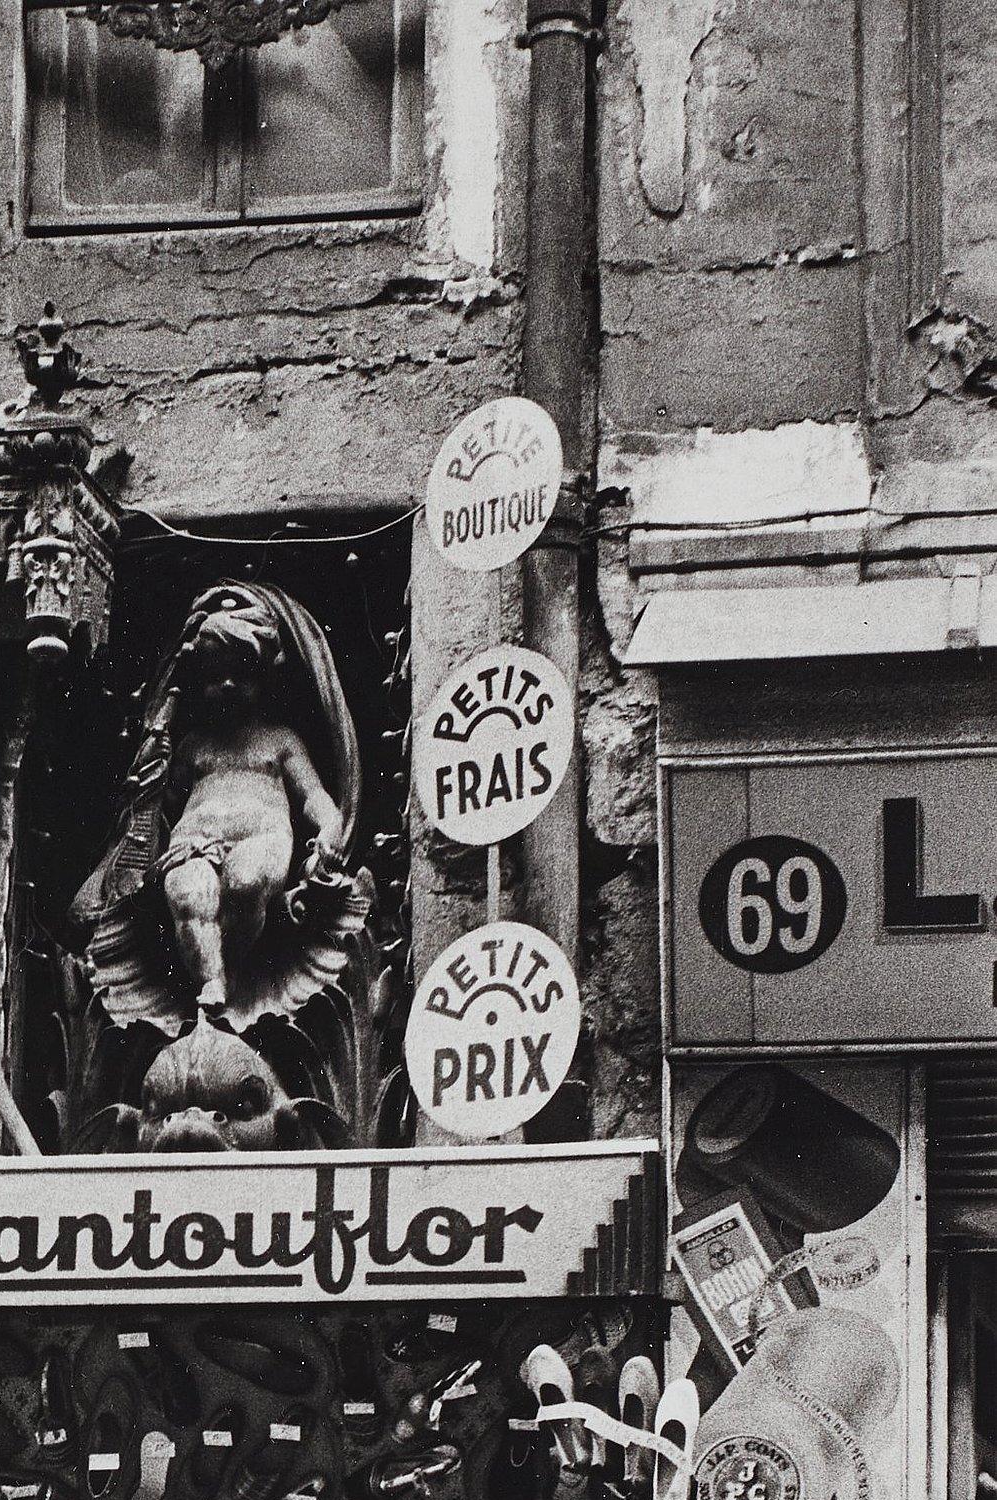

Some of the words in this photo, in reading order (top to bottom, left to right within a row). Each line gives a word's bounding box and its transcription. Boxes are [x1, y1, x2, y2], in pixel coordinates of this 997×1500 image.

[447, 420, 544, 481] PETITE
[443, 485, 547, 547] BOUTIQUE
[433, 666, 553, 742] PETITS
[436, 742, 552, 819] FRAIS
[881, 797, 997, 934] L
[727, 856, 823, 956] 69
[425, 940, 563, 1021] PETITS
[433, 1033, 552, 1107] PRIX
[700, 1256, 764, 1312] BOHIN
[738, 1461, 757, 1482] J
[744, 1440, 790, 1471] COATS
